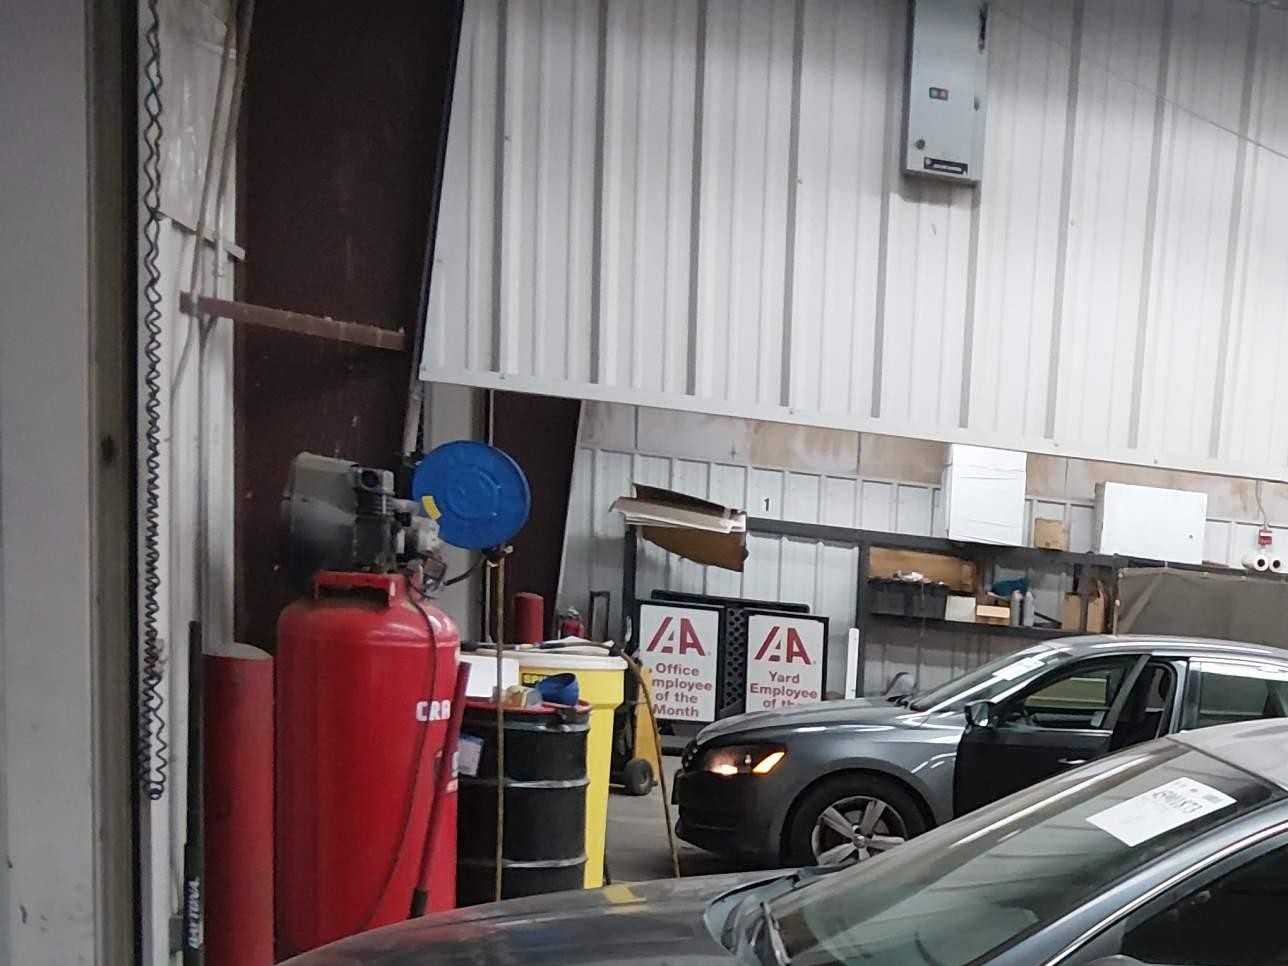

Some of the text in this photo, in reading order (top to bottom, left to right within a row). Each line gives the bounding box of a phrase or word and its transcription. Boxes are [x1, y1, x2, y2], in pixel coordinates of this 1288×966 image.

[763, 496, 770, 513] 1
[655, 662, 700, 677] Office
[769, 670, 800, 684] Yard
[651, 678, 713, 692] mployee
[750, 682, 818, 700] Employee
[655, 691, 698, 704] of the
[762, 699, 777, 710] of
[652, 703, 699, 718] Month
